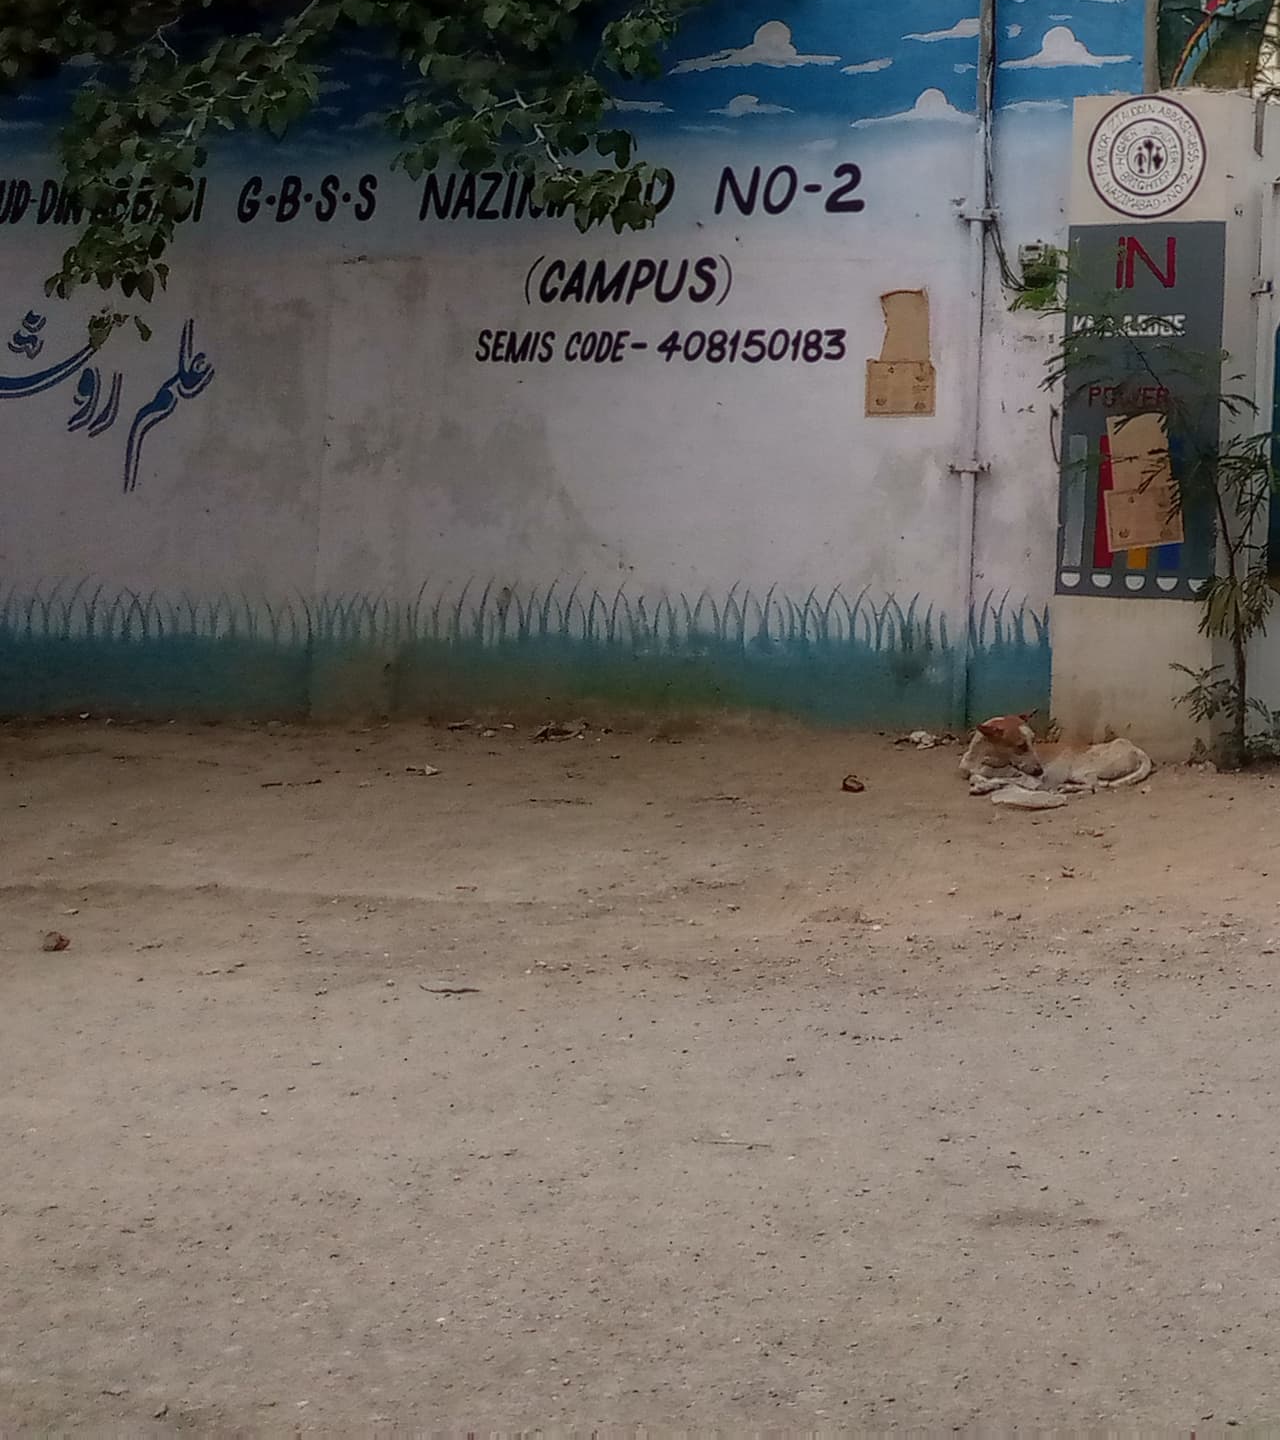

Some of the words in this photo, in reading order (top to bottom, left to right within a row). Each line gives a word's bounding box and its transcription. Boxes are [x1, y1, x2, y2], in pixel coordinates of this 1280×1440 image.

[419, 169, 676, 221] NAZIMD
[714, 163, 866, 216] NO-2
[524, 253, 732, 306] (CAMPUS)
[475, 329, 554, 364] SEMIS
[657, 328, 847, 364] 408150183
[123, 317, 216, 495] علم
